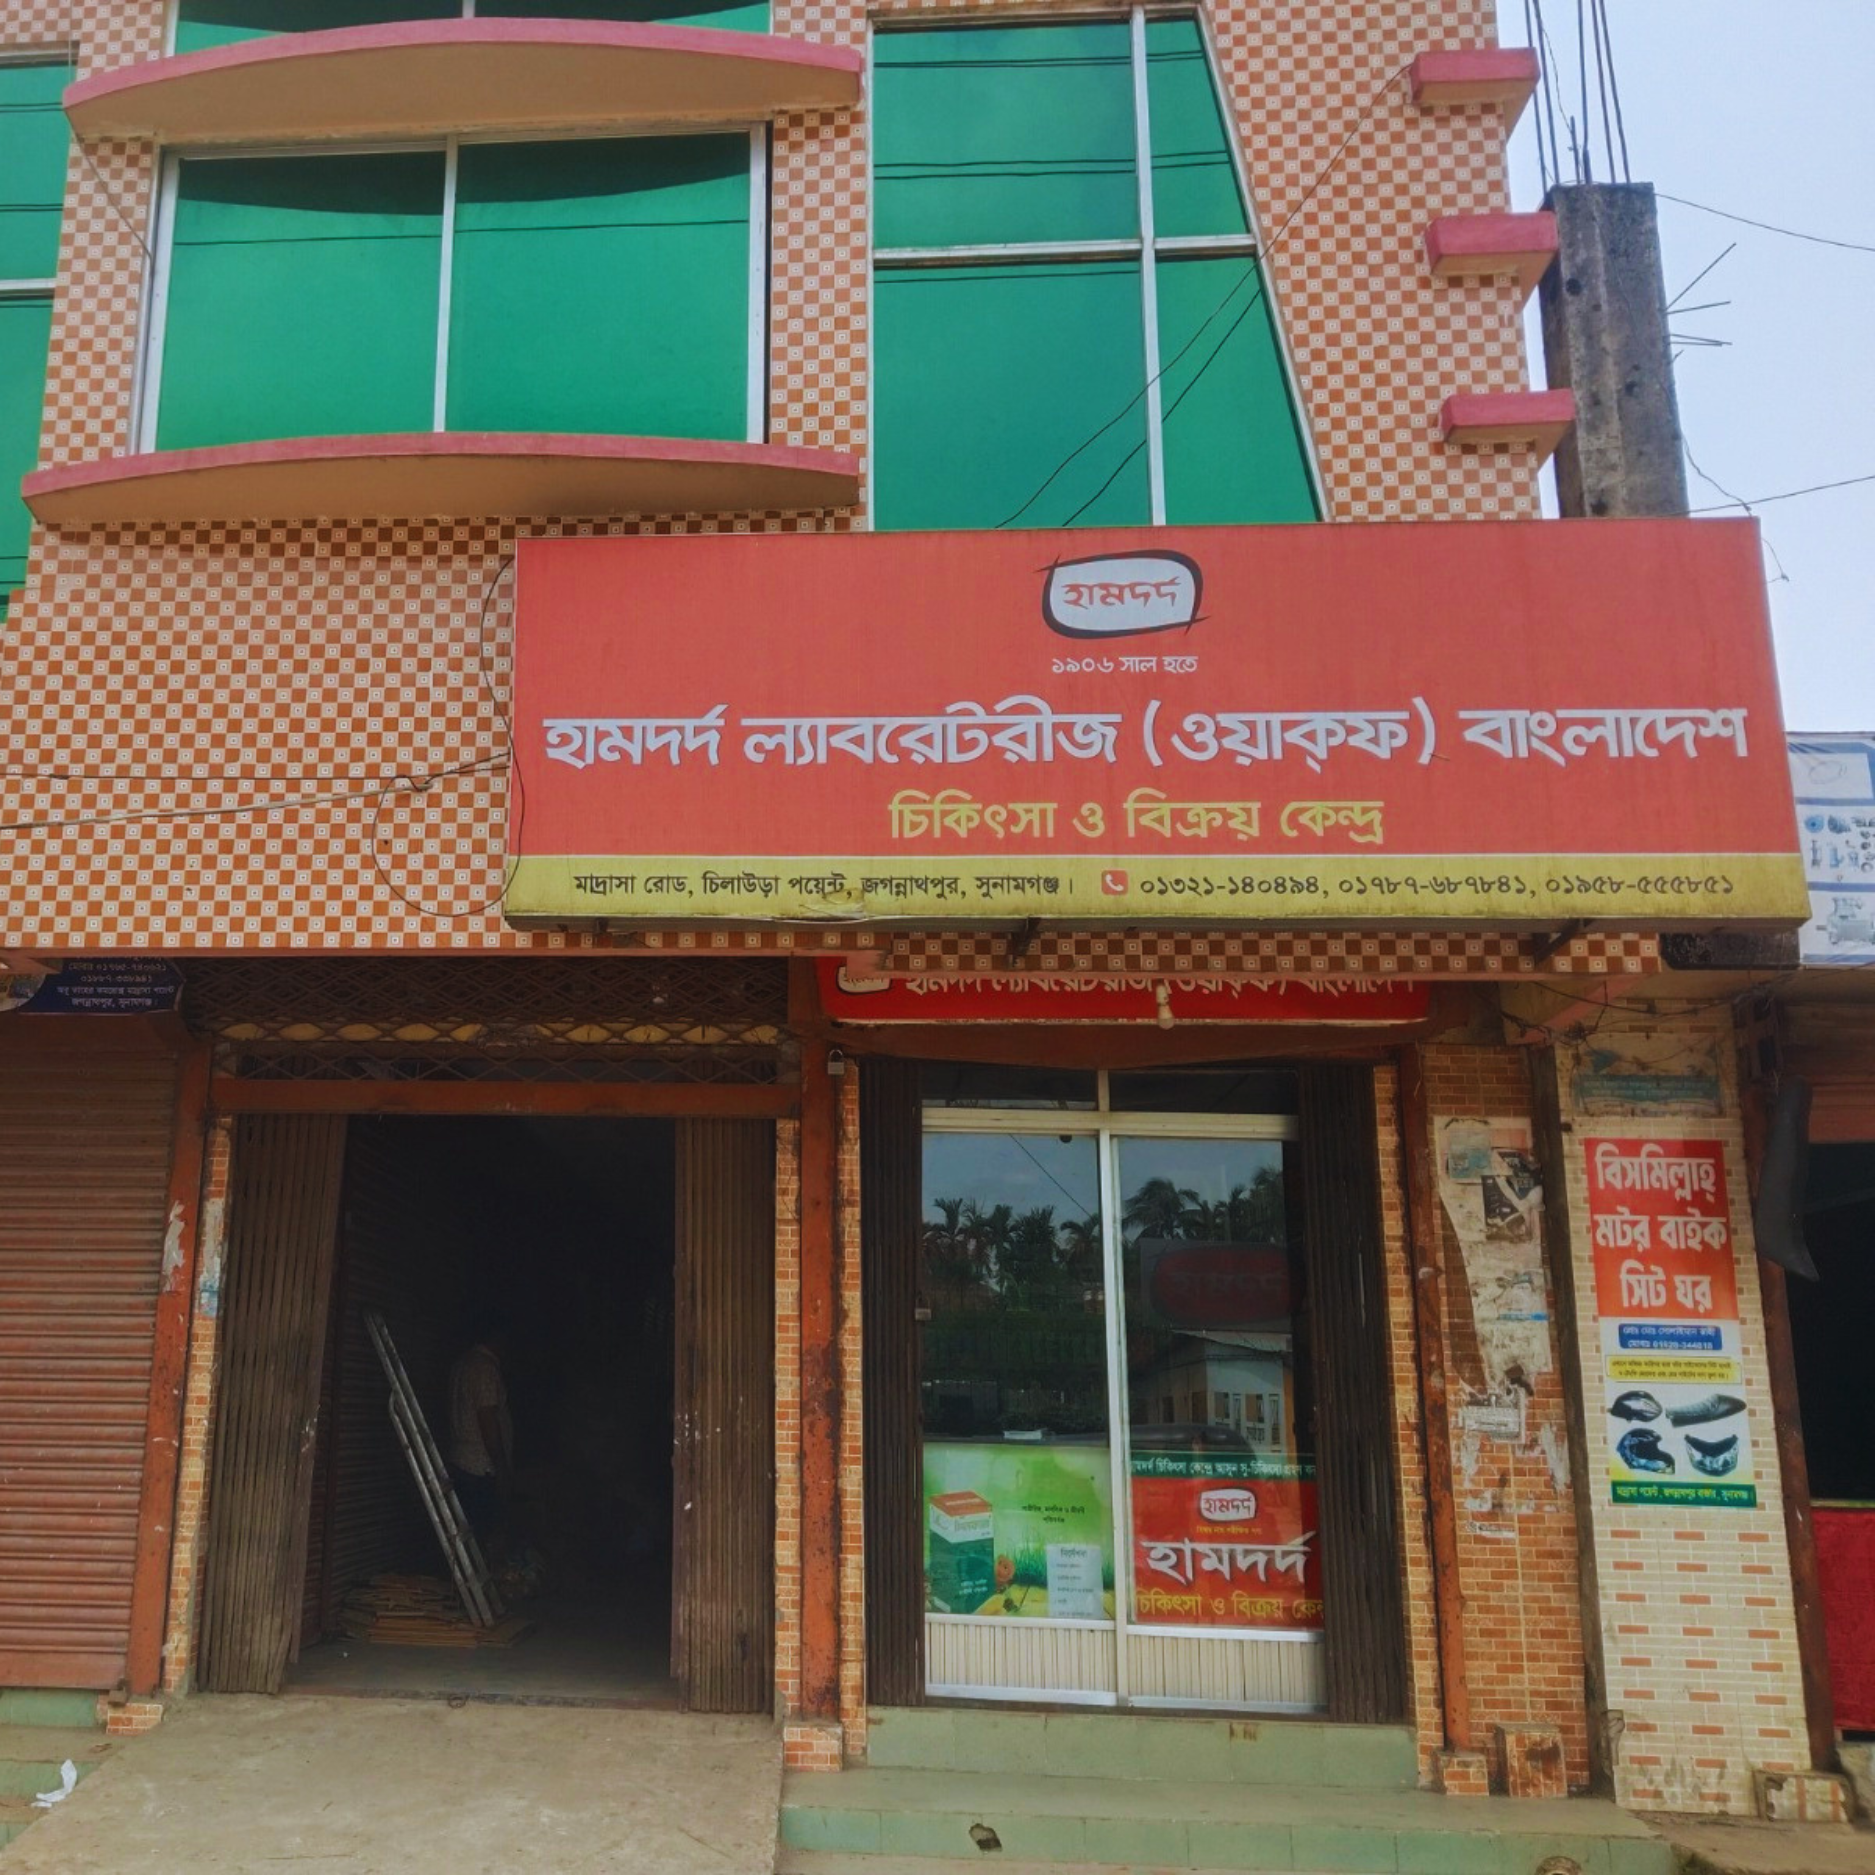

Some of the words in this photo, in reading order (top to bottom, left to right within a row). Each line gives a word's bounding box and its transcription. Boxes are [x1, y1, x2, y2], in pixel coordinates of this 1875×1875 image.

[1061, 576, 1182, 610] হামদর্দ
[1052, 657, 1114, 673] ১৯০৬
[1119, 656, 1157, 673] সাল
[1162, 655, 1199, 673] হতে
[543, 704, 729, 770] হামদর্দ
[741, 695, 1122, 766] ল্যাবরেটরীজ
[1458, 708, 1748, 767] বাংলাদেশ
[887, 789, 1058, 838] চিকিৎসা
[1072, 803, 1106, 838] ও
[1123, 787, 1261, 840] বিক্রয়
[1280, 801, 1384, 845] কেন্দ্র
[573, 873, 636, 896] মাদ্রাসা
[643, 873, 693, 898] রোড,
[701, 870, 781, 898] চিলাউড়া
[860, 873, 967, 899] জগন্নাথপুর,
[1140, 876, 1329, 898] ০১৩২১-১৪০৪৯৪,
[1338, 875, 1536, 898] ০১৭৮৭-৬৮৭৮৪১,
[1545, 875, 1734, 895] ০১৯৫৮-৫৫৫৮৫১
[1593, 1205, 1650, 1252] মটর
[1658, 1207, 1727, 1251] বাইক
[1620, 1259, 1666, 1308] সিট
[1674, 1275, 1712, 1313] ঘর
[1202, 1497, 1251, 1514] হামদর্দ
[1141, 1530, 1316, 1586] হামদর্দ
[1136, 1586, 1202, 1616] চিকিৎসা
[1211, 1598, 1225, 1615] ও
[1231, 1590, 1284, 1619] বিক্রয়
